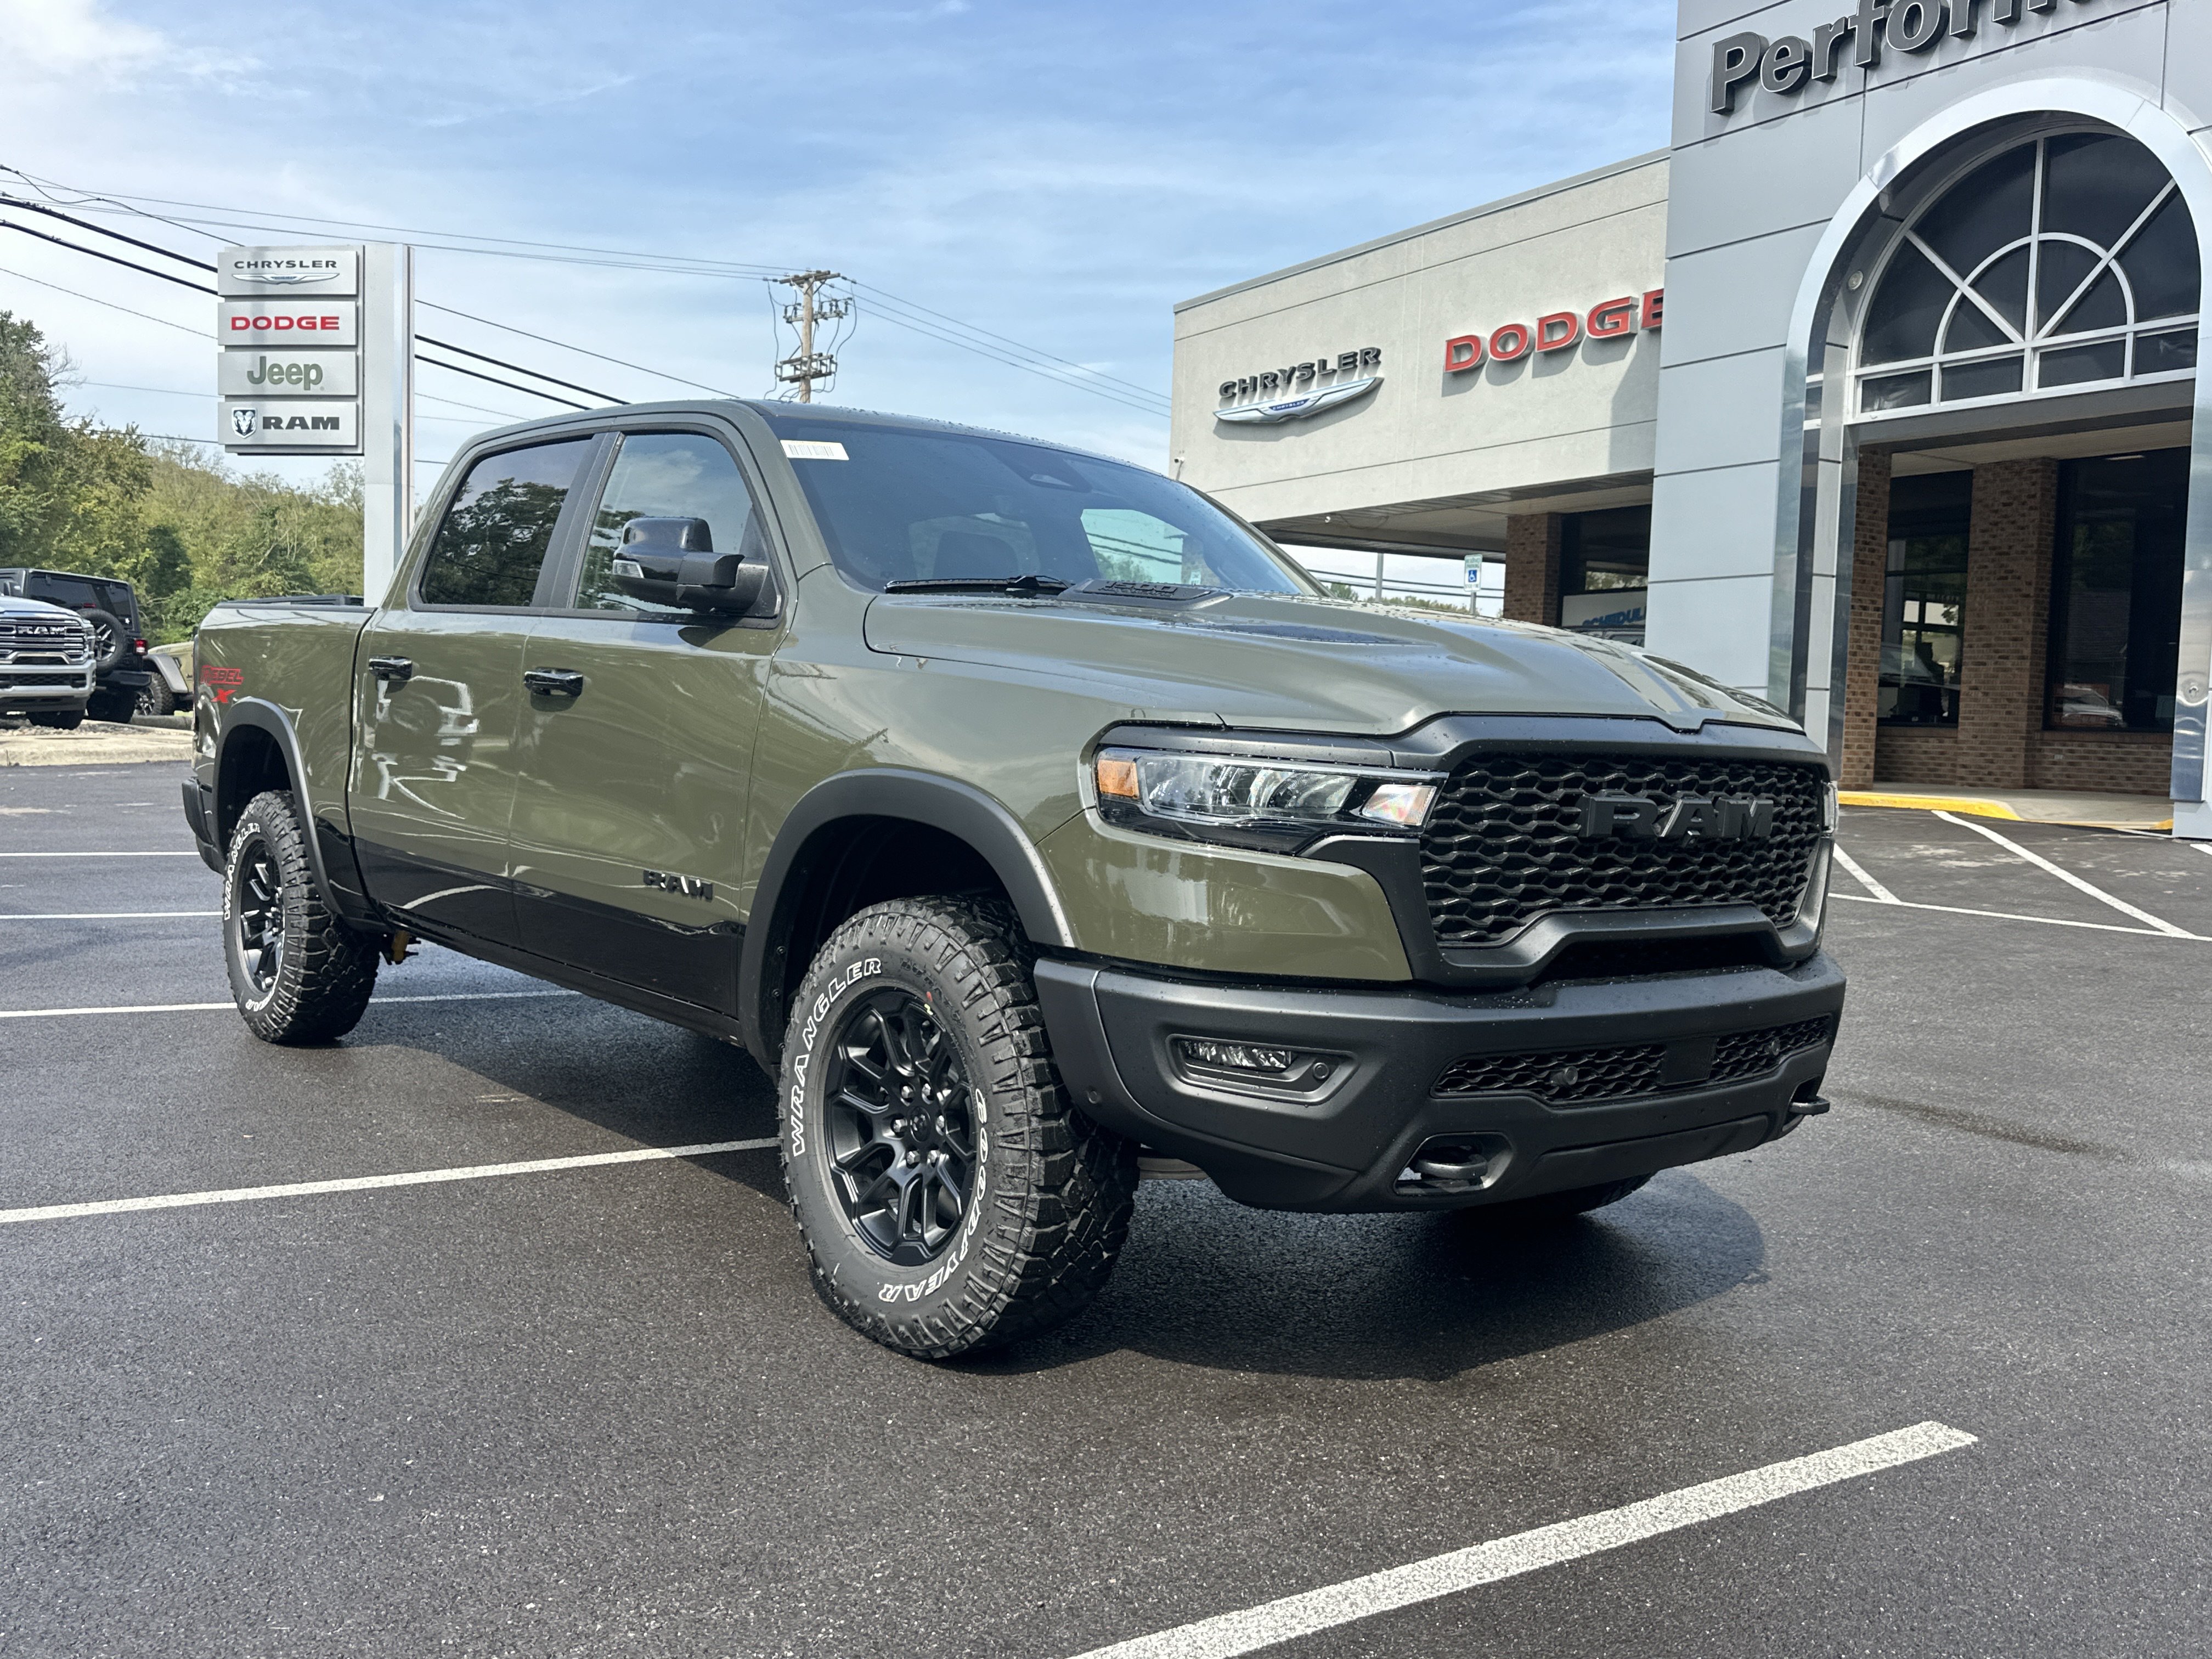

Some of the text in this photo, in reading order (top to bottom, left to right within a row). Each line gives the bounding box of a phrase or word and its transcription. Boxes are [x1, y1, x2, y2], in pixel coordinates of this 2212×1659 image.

[234, 260, 337, 269] CHRYSLER
[231, 316, 340, 330] DODGE
[247, 356, 323, 391] Jeep
[1219, 347, 1381, 398] CHRYSLER
[262, 416, 340, 430] RAM
[18, 626, 65, 635] RAM
[1576, 794, 1774, 838] RAM
[224, 823, 261, 921] WRANGLER
[643, 870, 713, 902] RAM
[791, 958, 883, 1156] WRANGLER
[878, 1088, 988, 1303] GOODYEAR
